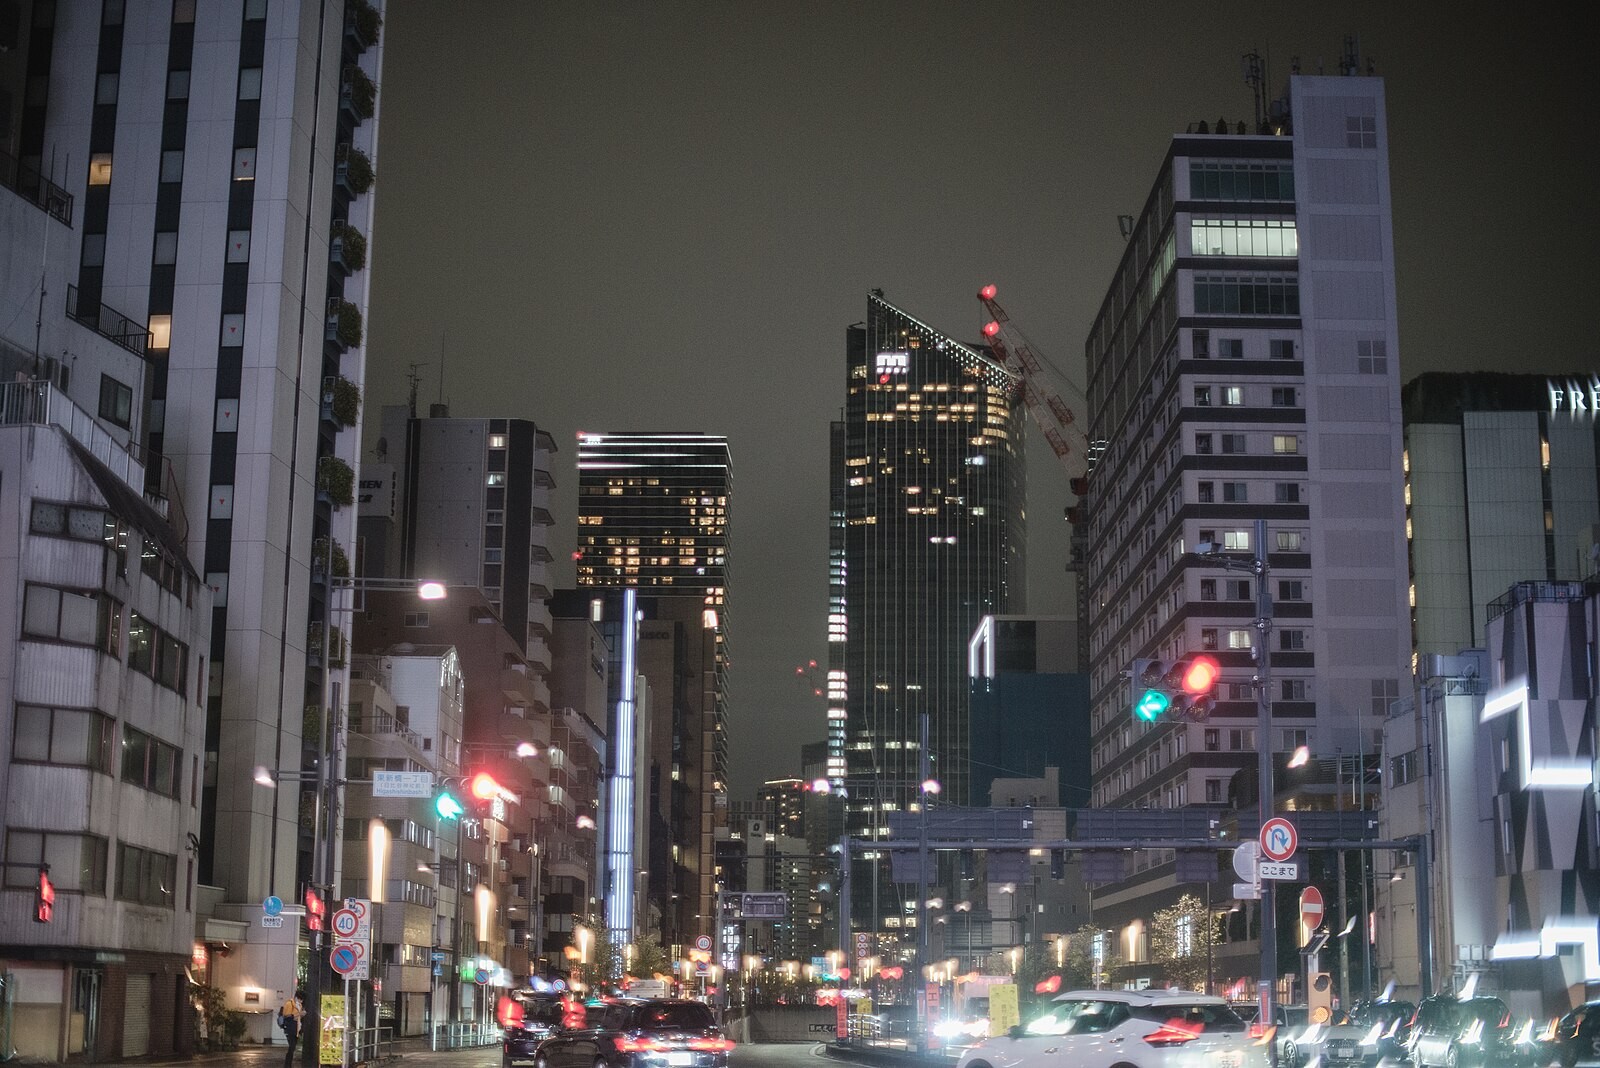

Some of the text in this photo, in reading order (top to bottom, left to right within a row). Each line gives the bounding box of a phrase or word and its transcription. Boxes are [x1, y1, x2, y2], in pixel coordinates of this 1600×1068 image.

[376, 773, 428, 783] 東新橋一丁目
[1262, 866, 1295, 876] ここまで
[338, 917, 353, 930] 40
[699, 939, 708, 947] 40
